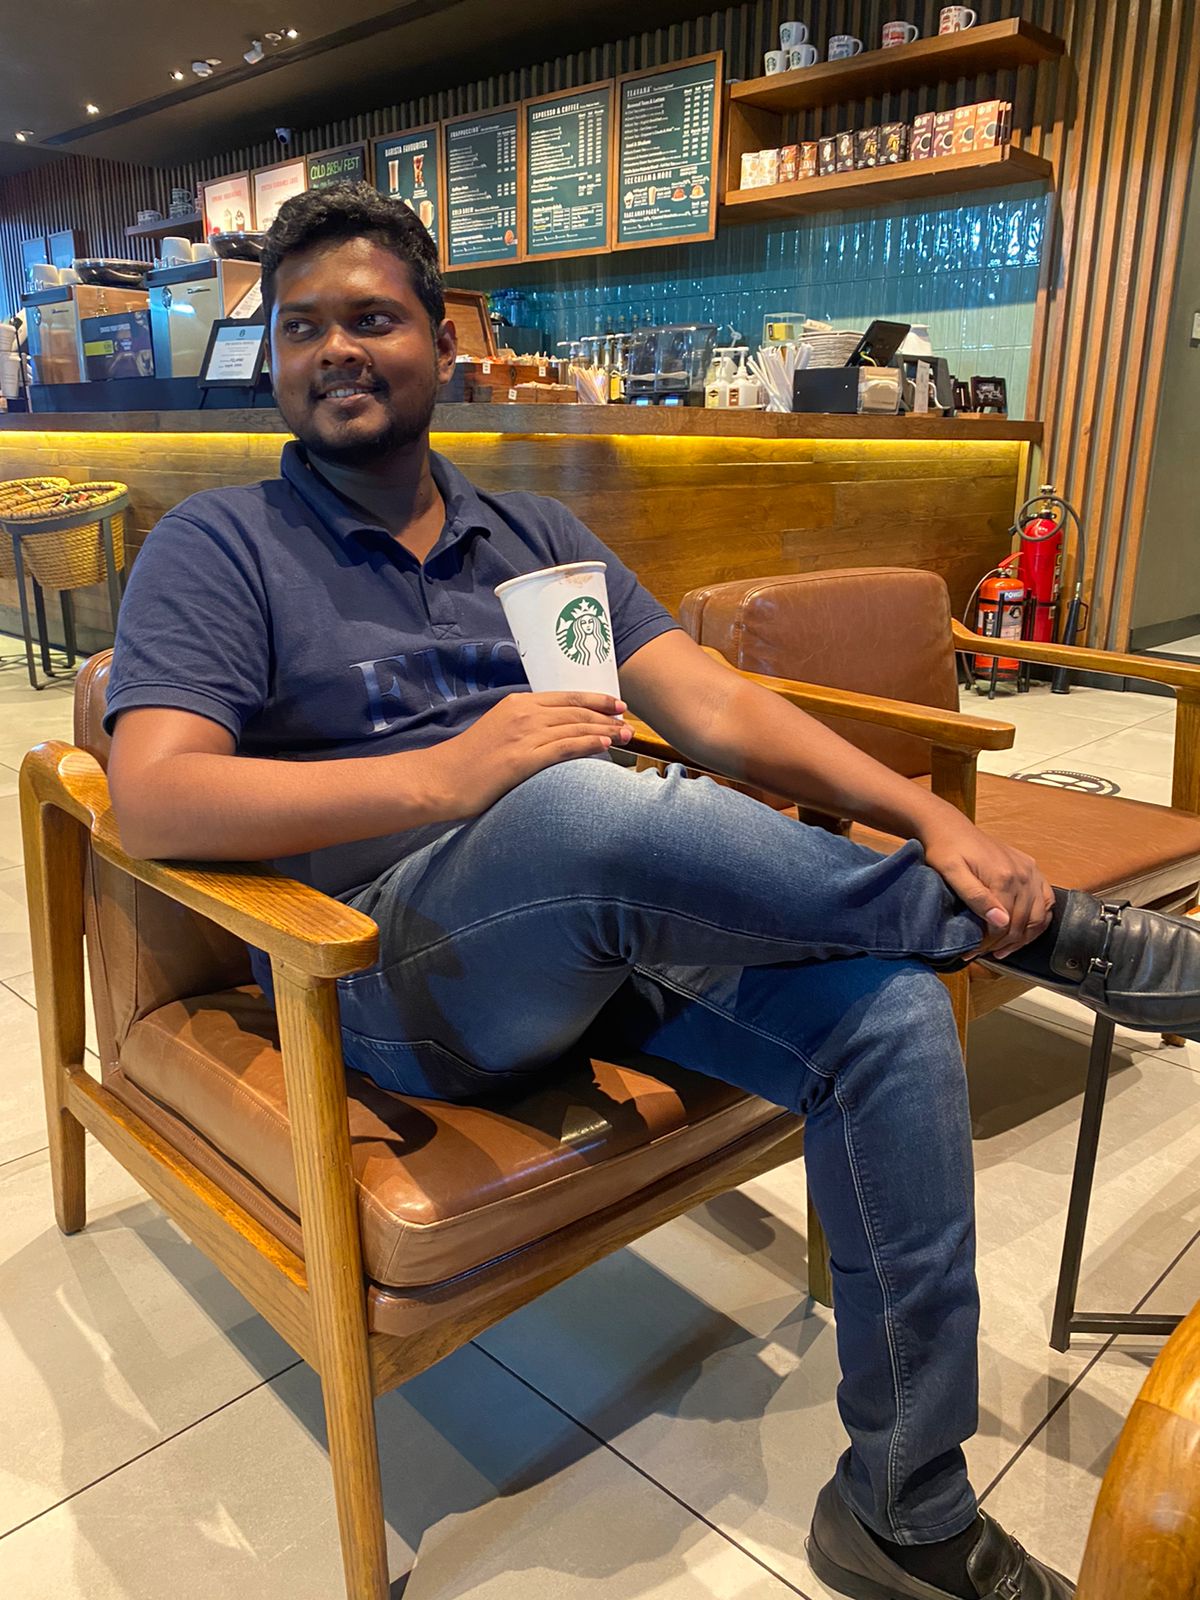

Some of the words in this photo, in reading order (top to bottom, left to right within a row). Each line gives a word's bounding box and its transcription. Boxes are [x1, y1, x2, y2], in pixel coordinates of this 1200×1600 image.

[532, 108, 556, 120] ESPRESSO
[561, 103, 580, 113] COFFEE
[385, 146, 402, 157] BARISTA
[310, 164, 326, 180] COLD
[326, 160, 343, 176] BREW
[343, 156, 360, 171] FEST
[624, 177, 634, 185] ICE
[633, 174, 652, 183] CREAM
